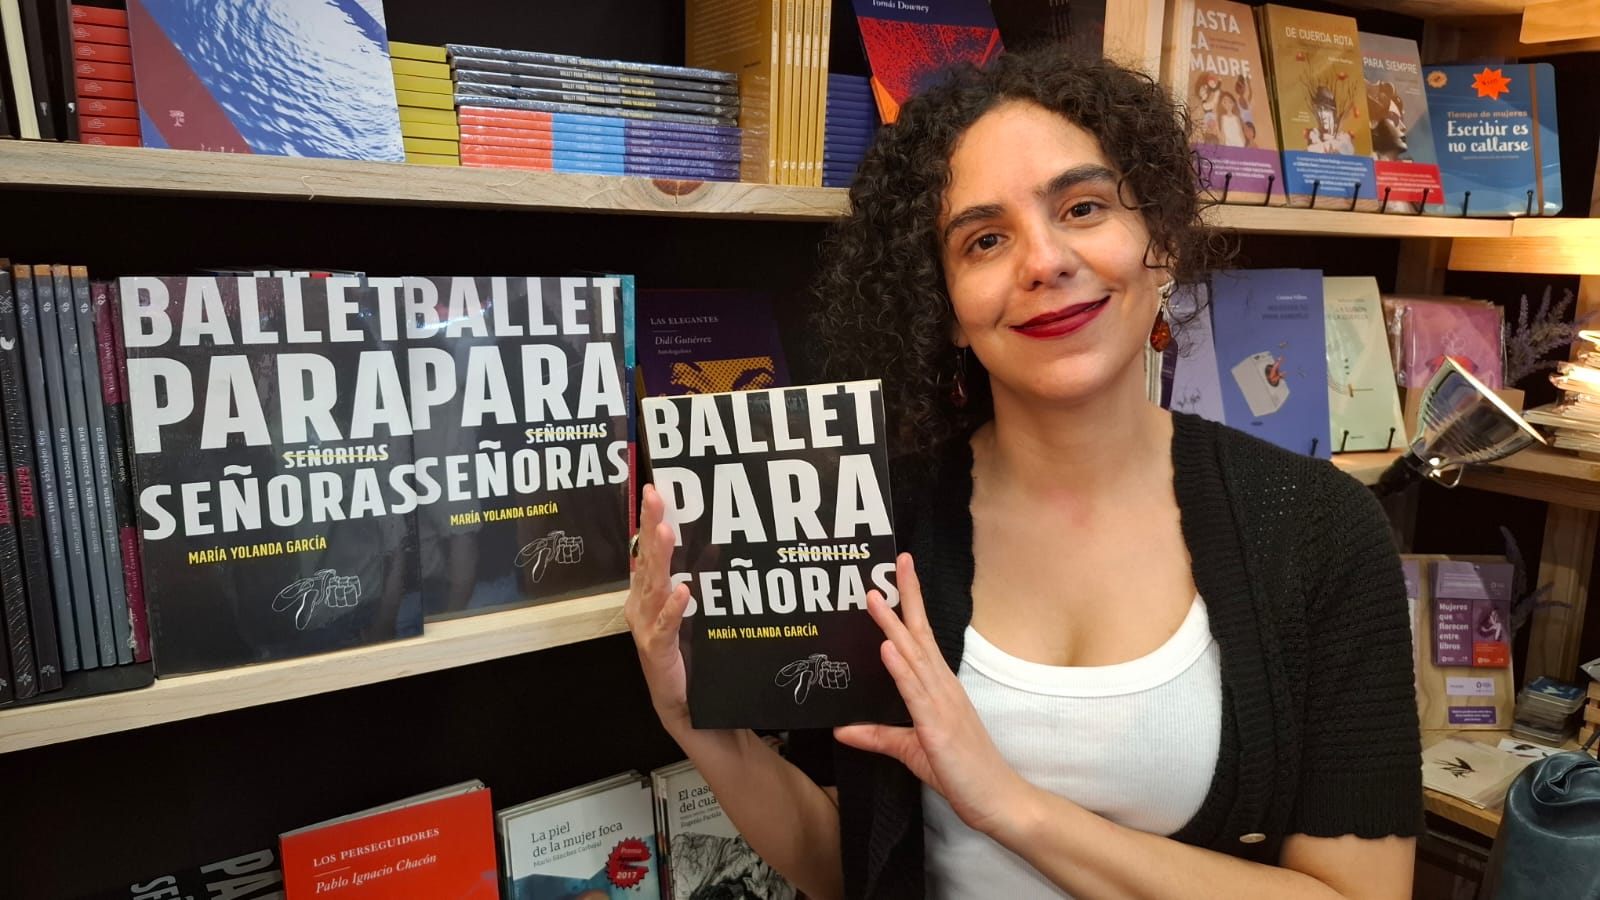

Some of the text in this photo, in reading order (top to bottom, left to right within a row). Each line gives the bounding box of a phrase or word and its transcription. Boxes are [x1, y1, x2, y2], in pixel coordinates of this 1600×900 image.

[872, 0, 929, 13] Tomás Downey
[1195, 8, 1240, 34] ASTA
[1285, 26, 1354, 47] DE CUERDA ROTA
[1190, 53, 1252, 80] MADRE
[1363, 56, 1384, 70] PARA
[1386, 60, 1418, 74] SIEMPRE
[1446, 111, 1478, 119] Tiempo
[1493, 110, 1528, 119] mujeres
[1448, 120, 1528, 136] Escribir es
[1449, 136, 1530, 152] no callarse
[120, 276, 403, 348] BALLET
[403, 276, 622, 340] BALLET
[650, 316, 719, 326] LAS ELEGANTES
[655, 335, 712, 345] Didí Gutiérrez
[408, 342, 626, 430] PARA
[126, 350, 414, 454] PARA
[642, 382, 879, 460] BALLET
[525, 423, 607, 444] SEÑORITAS
[60, 427, 68, 442] DÍAS
[67, 488, 75, 508] NUBES
[78, 426, 86, 442] DÍAS
[86, 487, 94, 508] NUBES
[96, 426, 104, 442] DÍAS
[103, 488, 111, 508] NUBES
[283, 444, 389, 468] SEÑORITAS
[416, 440, 629, 505] SEÑORAS
[139, 464, 418, 540] SEÑORAS
[651, 454, 893, 546] PARA
[450, 502, 558, 526] MARÍA YOLANDA GARCÍA
[188, 536, 327, 566] MARÍA YOLANDA GARCÍA
[778, 542, 870, 564] SEÑORITAS
[672, 558, 900, 618] SEÑORAS
[1440, 603, 1468, 612] Mujeres
[708, 622, 818, 640] MARÍA YOLANDA GARCÍA
[1440, 642, 1460, 650] libros
[678, 790, 690, 801] El
[680, 801, 696, 814] del
[697, 796, 718, 809] cua
[531, 821, 570, 844] La piel
[532, 820, 624, 858] de la mujer foca
[313, 827, 440, 868] LOS PERSEGUIDORES
[316, 852, 437, 894] Pablo Ignacio Chacón
[616, 870, 638, 880] 2017
